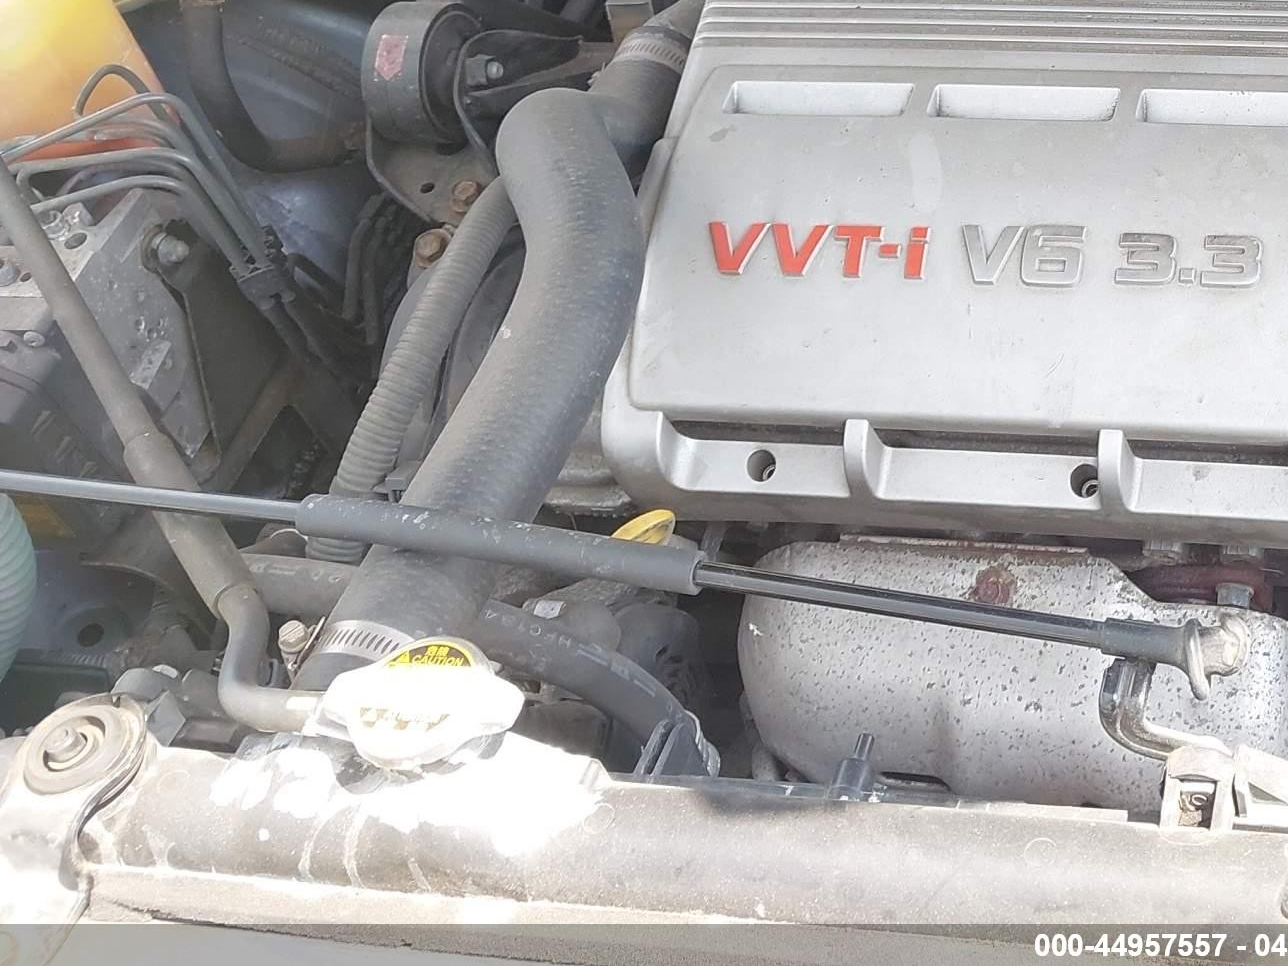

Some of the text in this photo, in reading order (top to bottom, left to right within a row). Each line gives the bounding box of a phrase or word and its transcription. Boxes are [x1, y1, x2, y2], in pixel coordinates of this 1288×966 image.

[708, 220, 1265, 289] VVT-i V6 3.3
[412, 655, 465, 667] CAUTION
